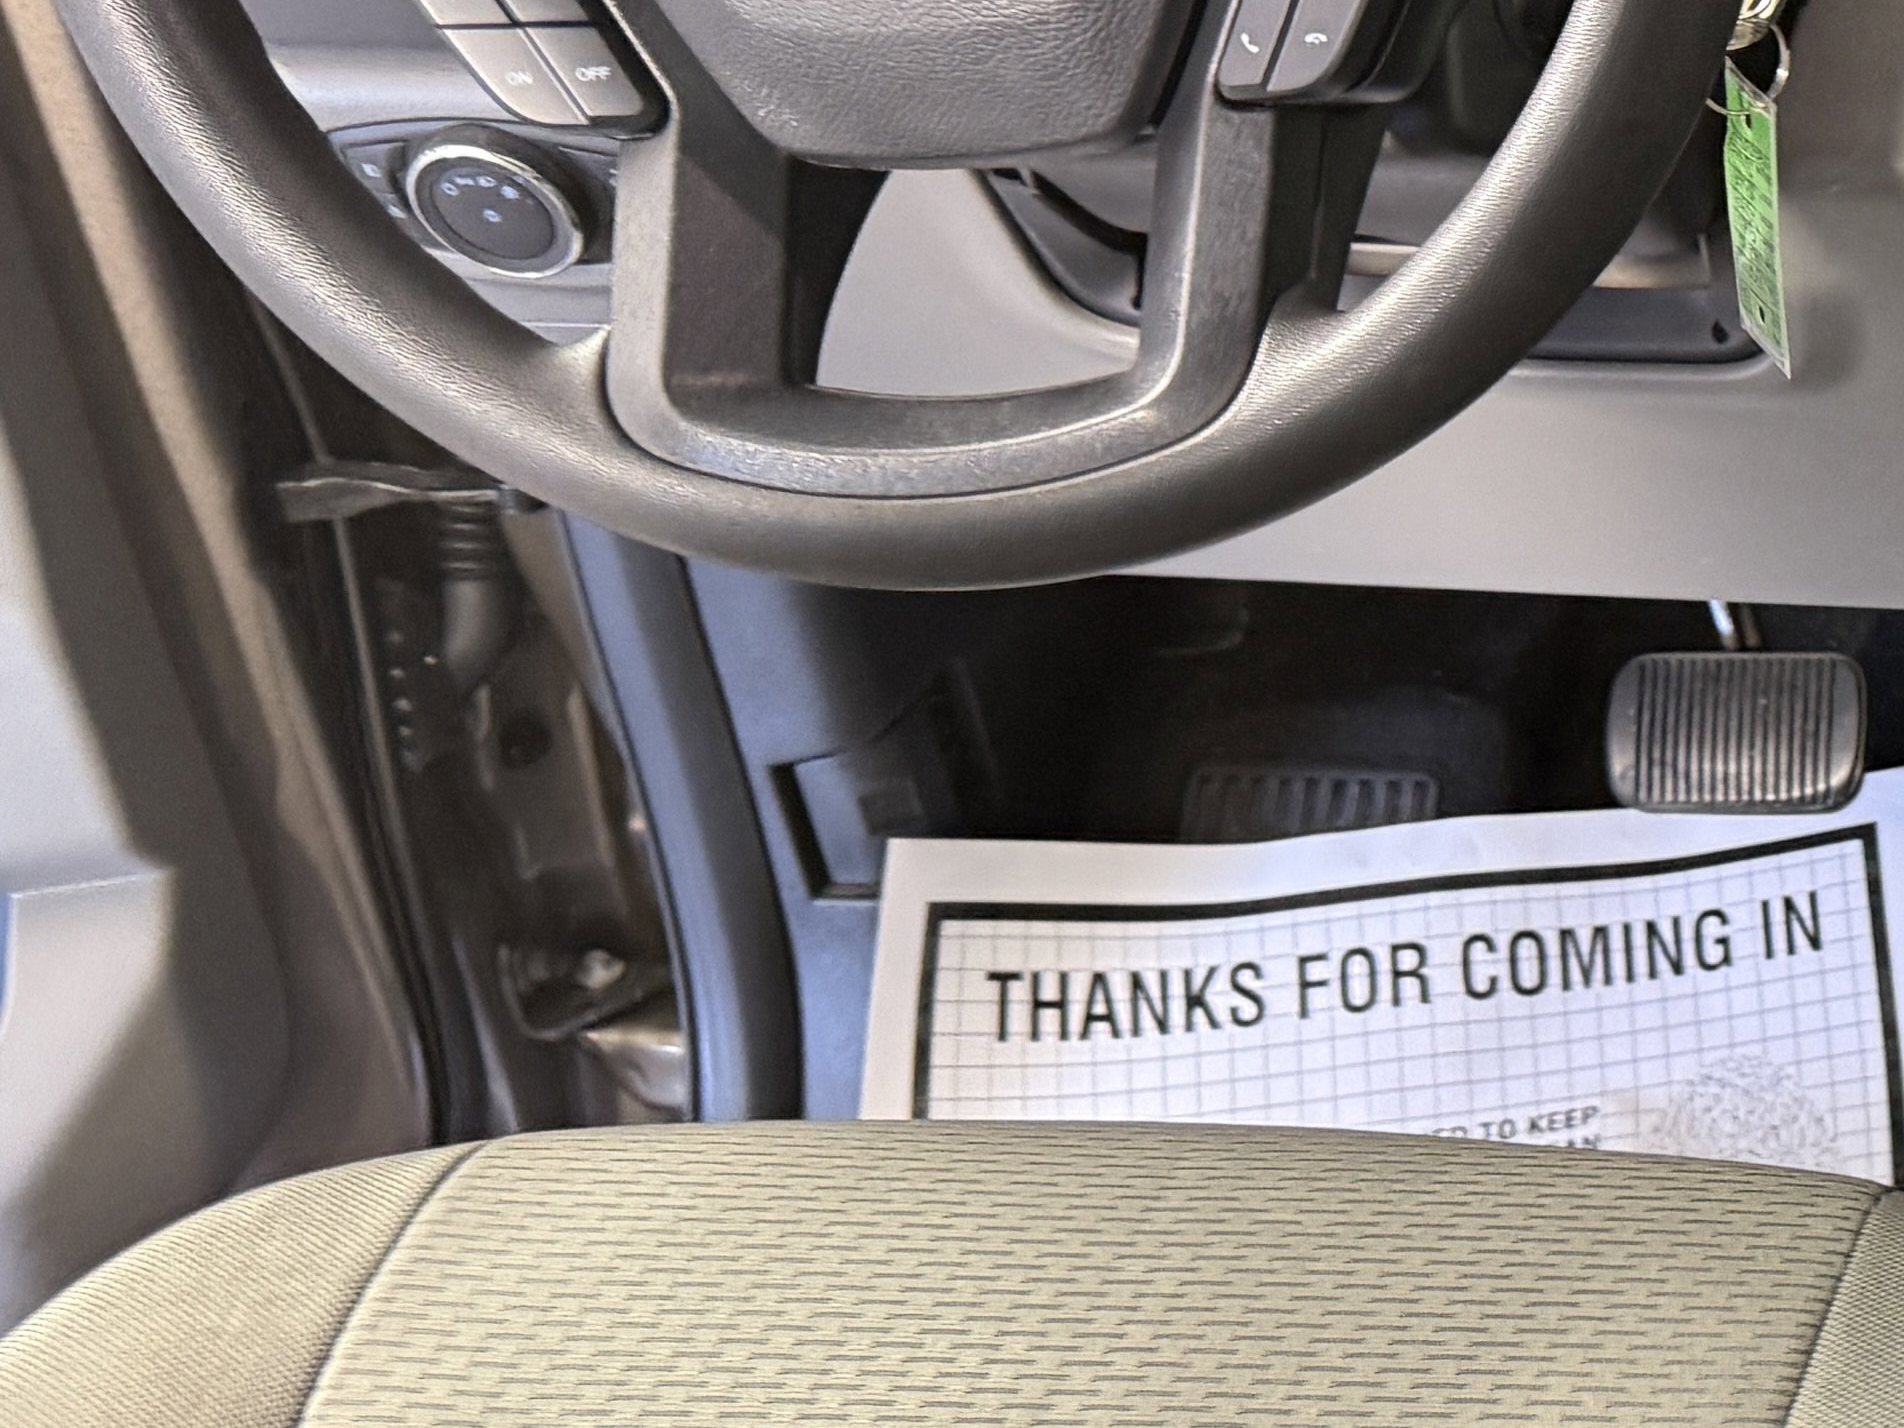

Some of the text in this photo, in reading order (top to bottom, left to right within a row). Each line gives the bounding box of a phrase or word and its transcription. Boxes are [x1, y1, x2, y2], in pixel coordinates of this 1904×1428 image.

[986, 890, 1824, 1044] THANKS FOR COMING IN
[1478, 1118, 1515, 1140] TO
[1528, 1105, 1600, 1134] KEEP
